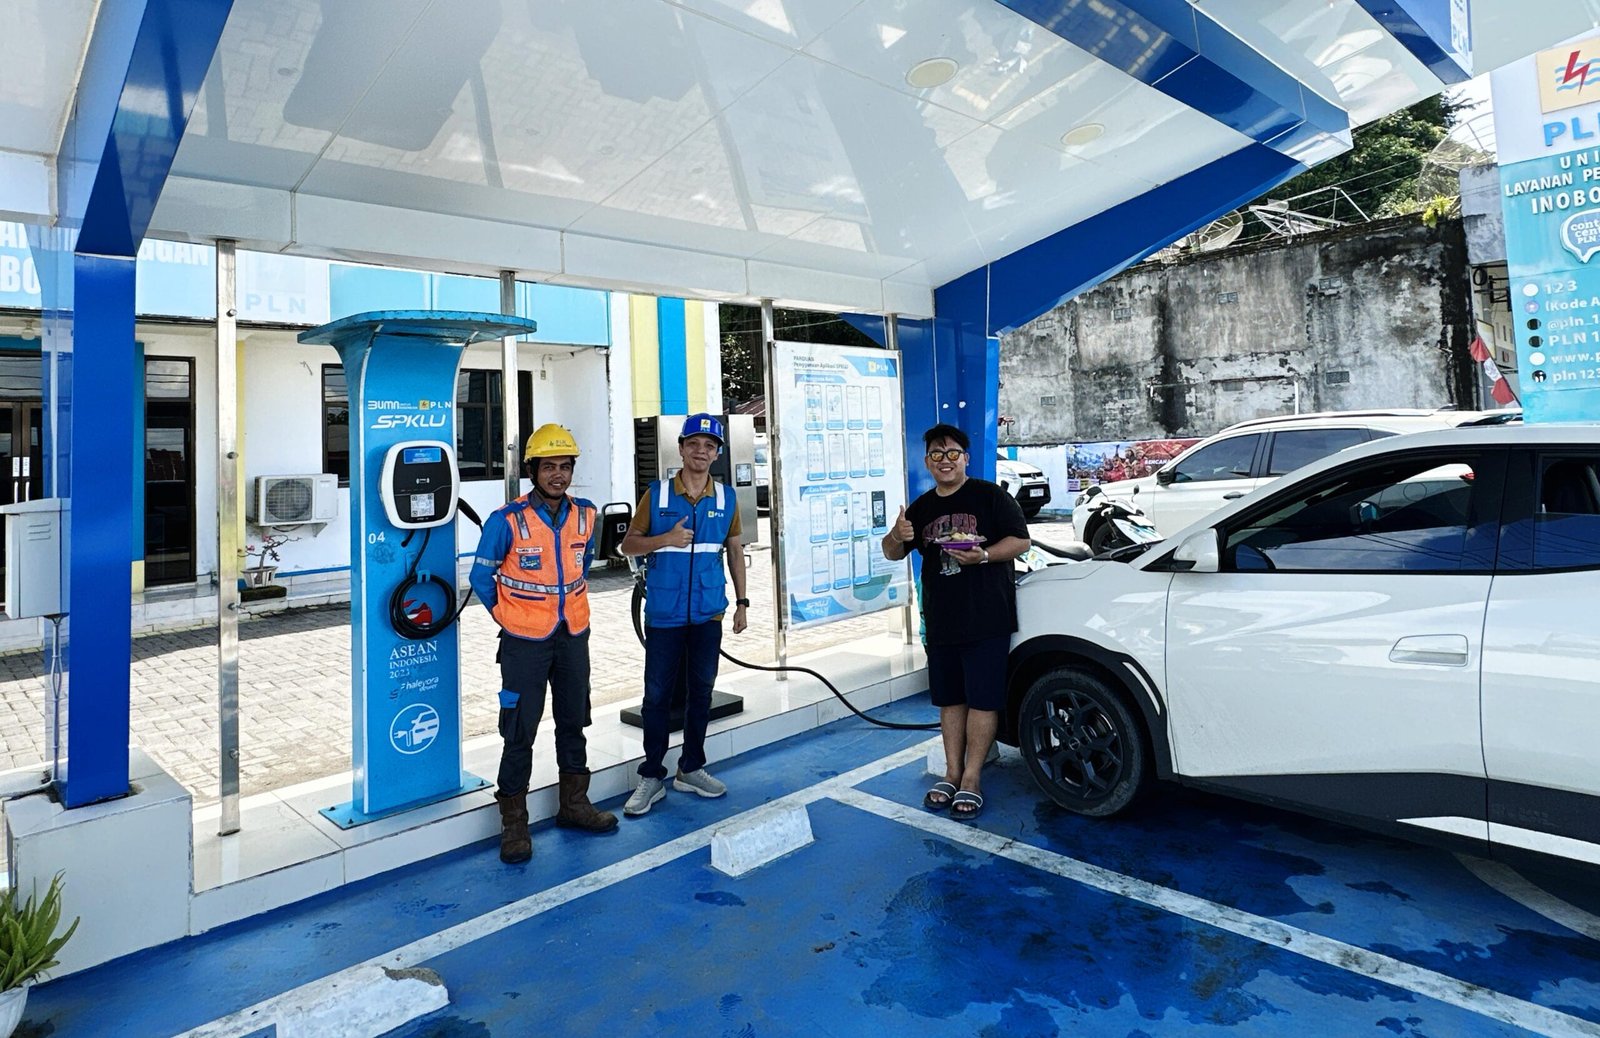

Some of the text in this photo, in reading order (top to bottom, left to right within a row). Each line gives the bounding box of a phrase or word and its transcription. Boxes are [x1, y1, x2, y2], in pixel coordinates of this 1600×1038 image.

[1543, 112, 1600, 147] PL
[1504, 172, 1573, 197] LAYANAN
[1531, 186, 1600, 214] INOBO
[1577, 235, 1597, 244] PLN
[1544, 280, 1577, 295] 123
[245, 293, 306, 314] PLN
[1549, 332, 1587, 347] PLN
[1552, 370, 1577, 384] pln
[430, 401, 452, 409] PLN
[370, 414, 446, 429] SPKLU
[368, 531, 386, 545] 04
[390, 640, 438, 660] ASEAN
[389, 654, 438, 670] INDONESIA
